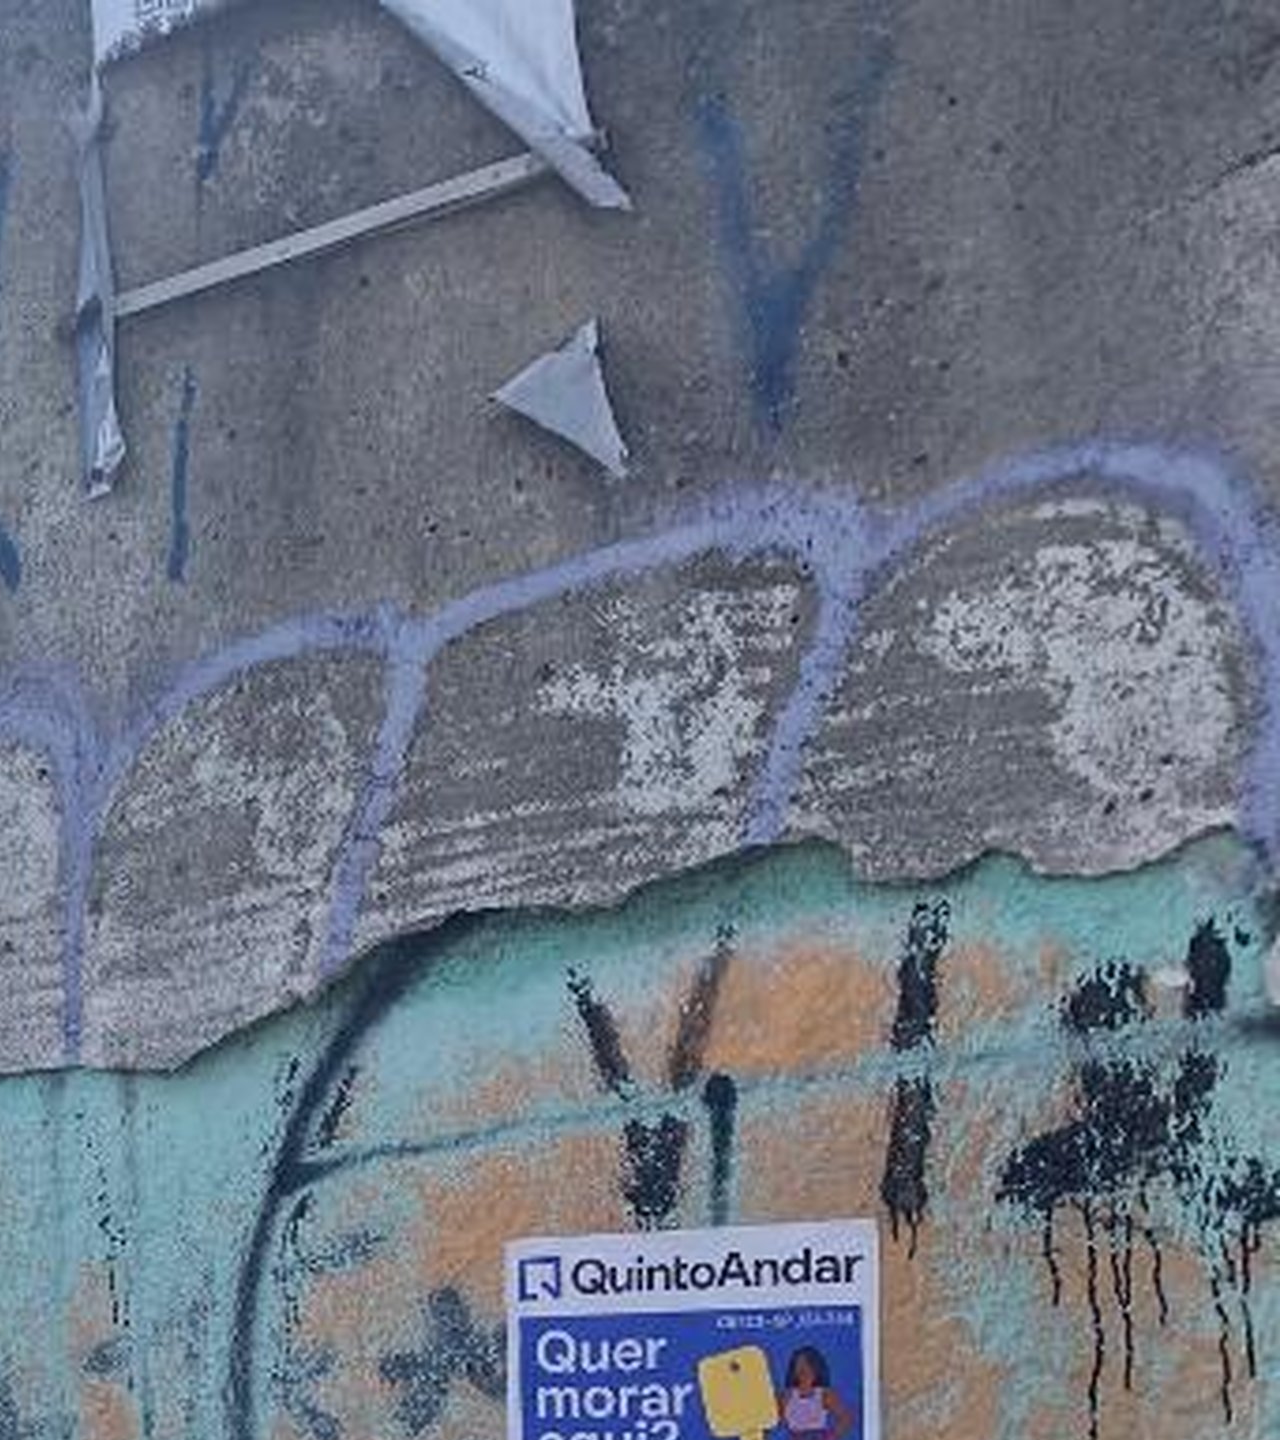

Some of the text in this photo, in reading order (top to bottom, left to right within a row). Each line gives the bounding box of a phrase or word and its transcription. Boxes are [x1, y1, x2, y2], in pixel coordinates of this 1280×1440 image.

[571, 1248, 864, 1295] QuintoAndar
[537, 1330, 667, 1374] Quer
[537, 1381, 694, 1421] morar
